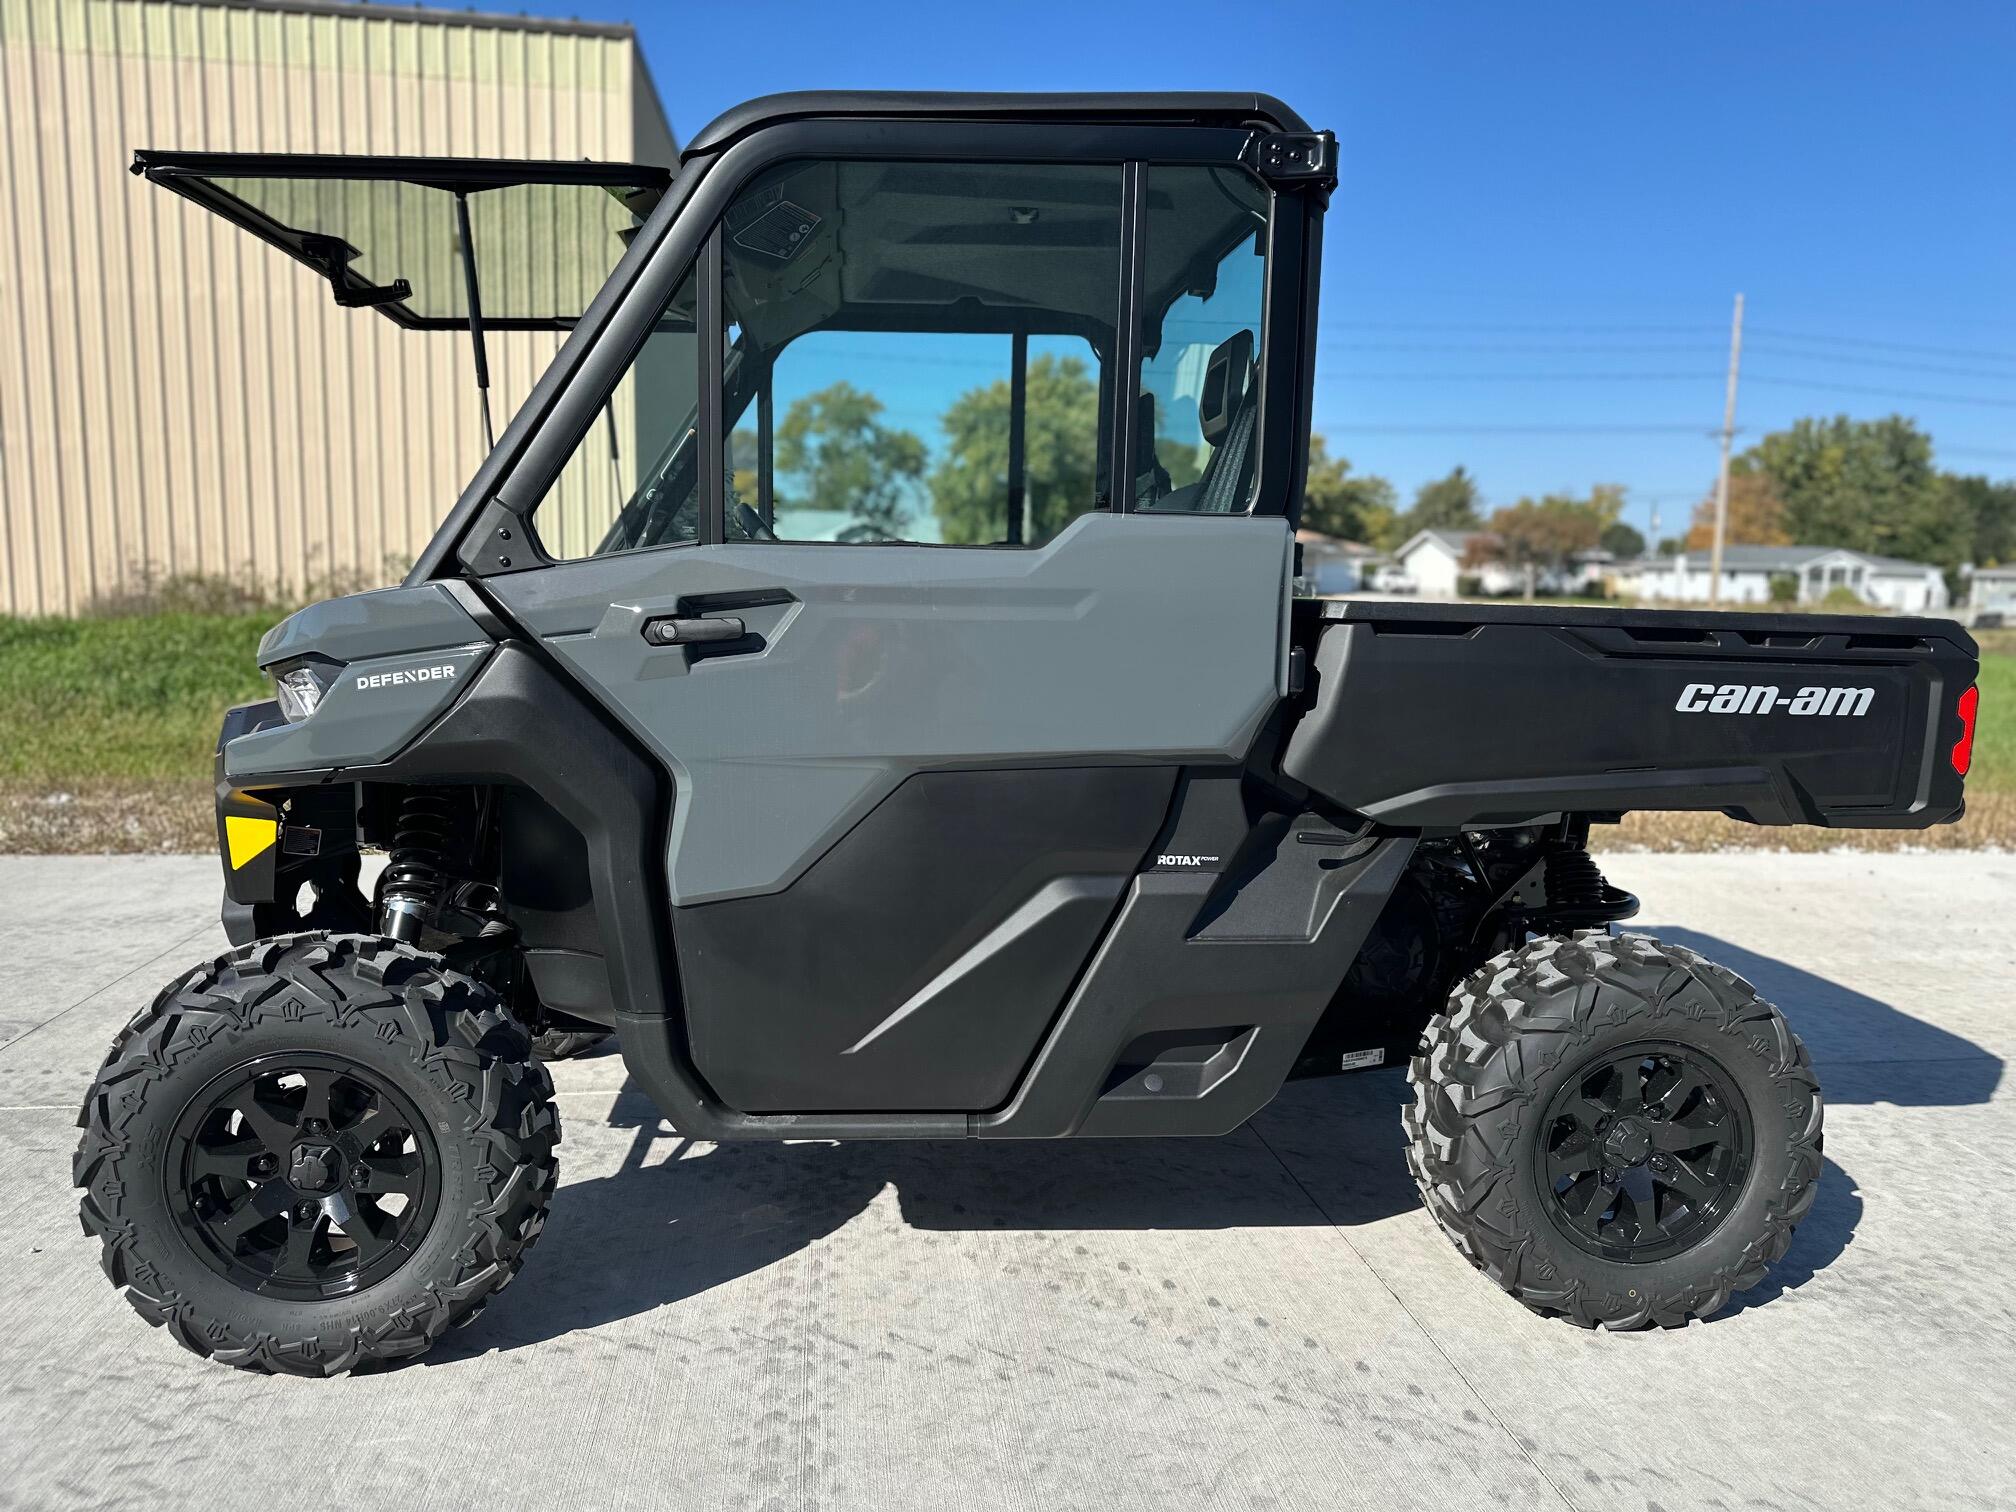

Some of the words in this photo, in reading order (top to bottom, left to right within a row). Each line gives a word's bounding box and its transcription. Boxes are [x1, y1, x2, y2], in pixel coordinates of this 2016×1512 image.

[357, 666, 455, 690] DEFENDER
[1675, 683, 1875, 716] can-am
[1157, 855, 1201, 866] ROTAX
